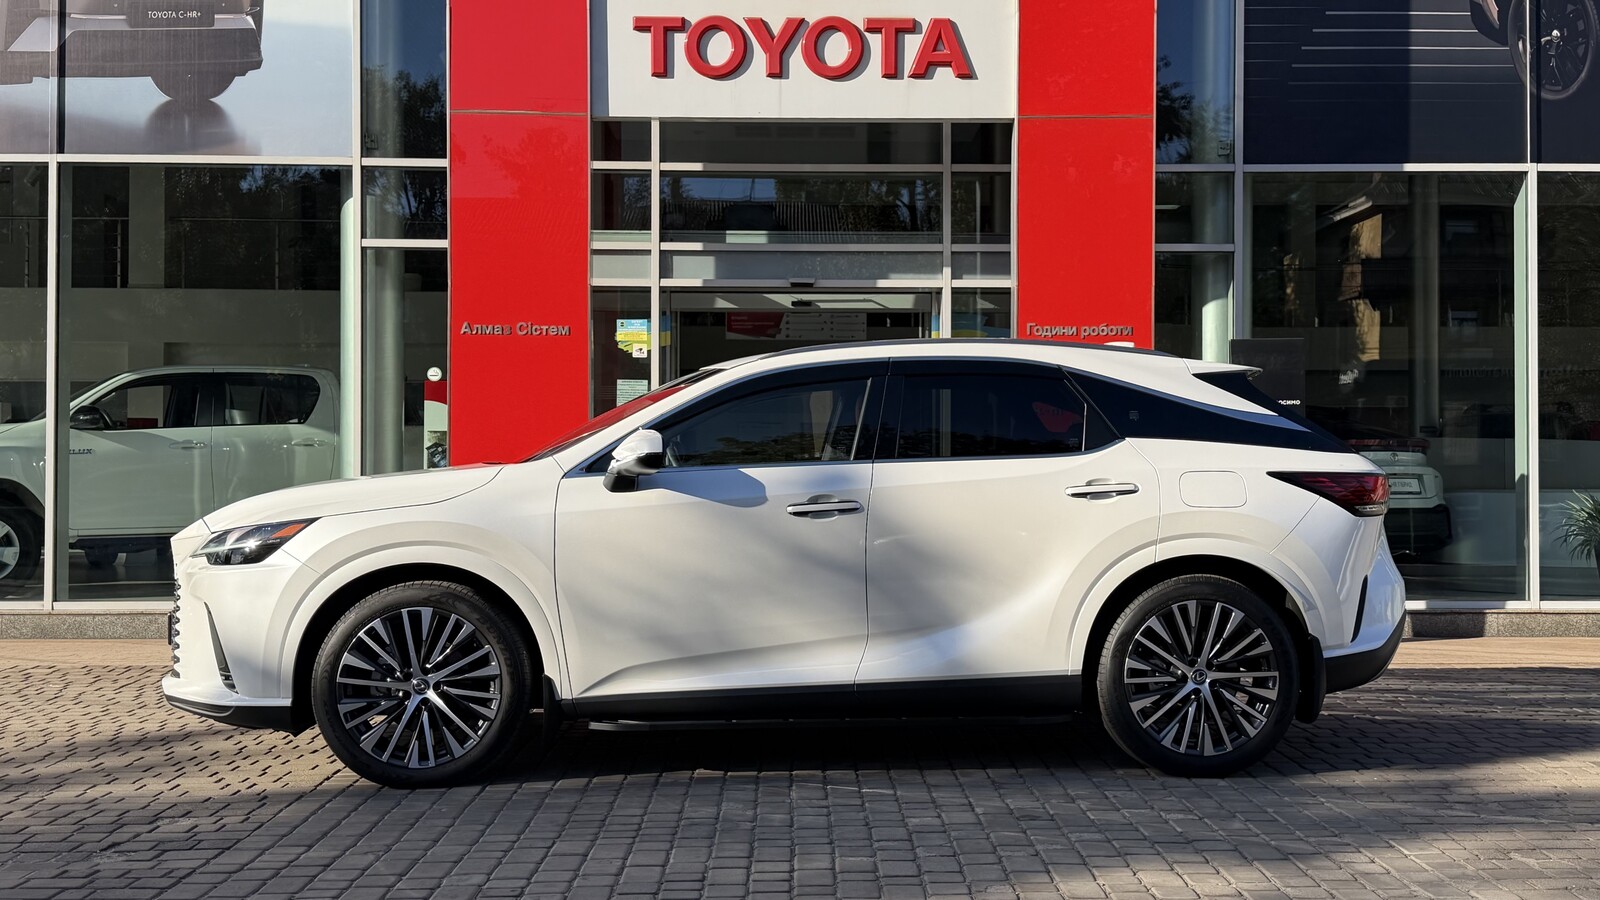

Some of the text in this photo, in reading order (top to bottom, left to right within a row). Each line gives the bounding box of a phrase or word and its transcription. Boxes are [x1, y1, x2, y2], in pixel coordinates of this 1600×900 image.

[178, 10, 201, 18] C-HR+
[633, 16, 973, 78] TOYOTA
[460, 321, 571, 336] Алмаз Сістем
[1026, 323, 1134, 340] Години роботи
